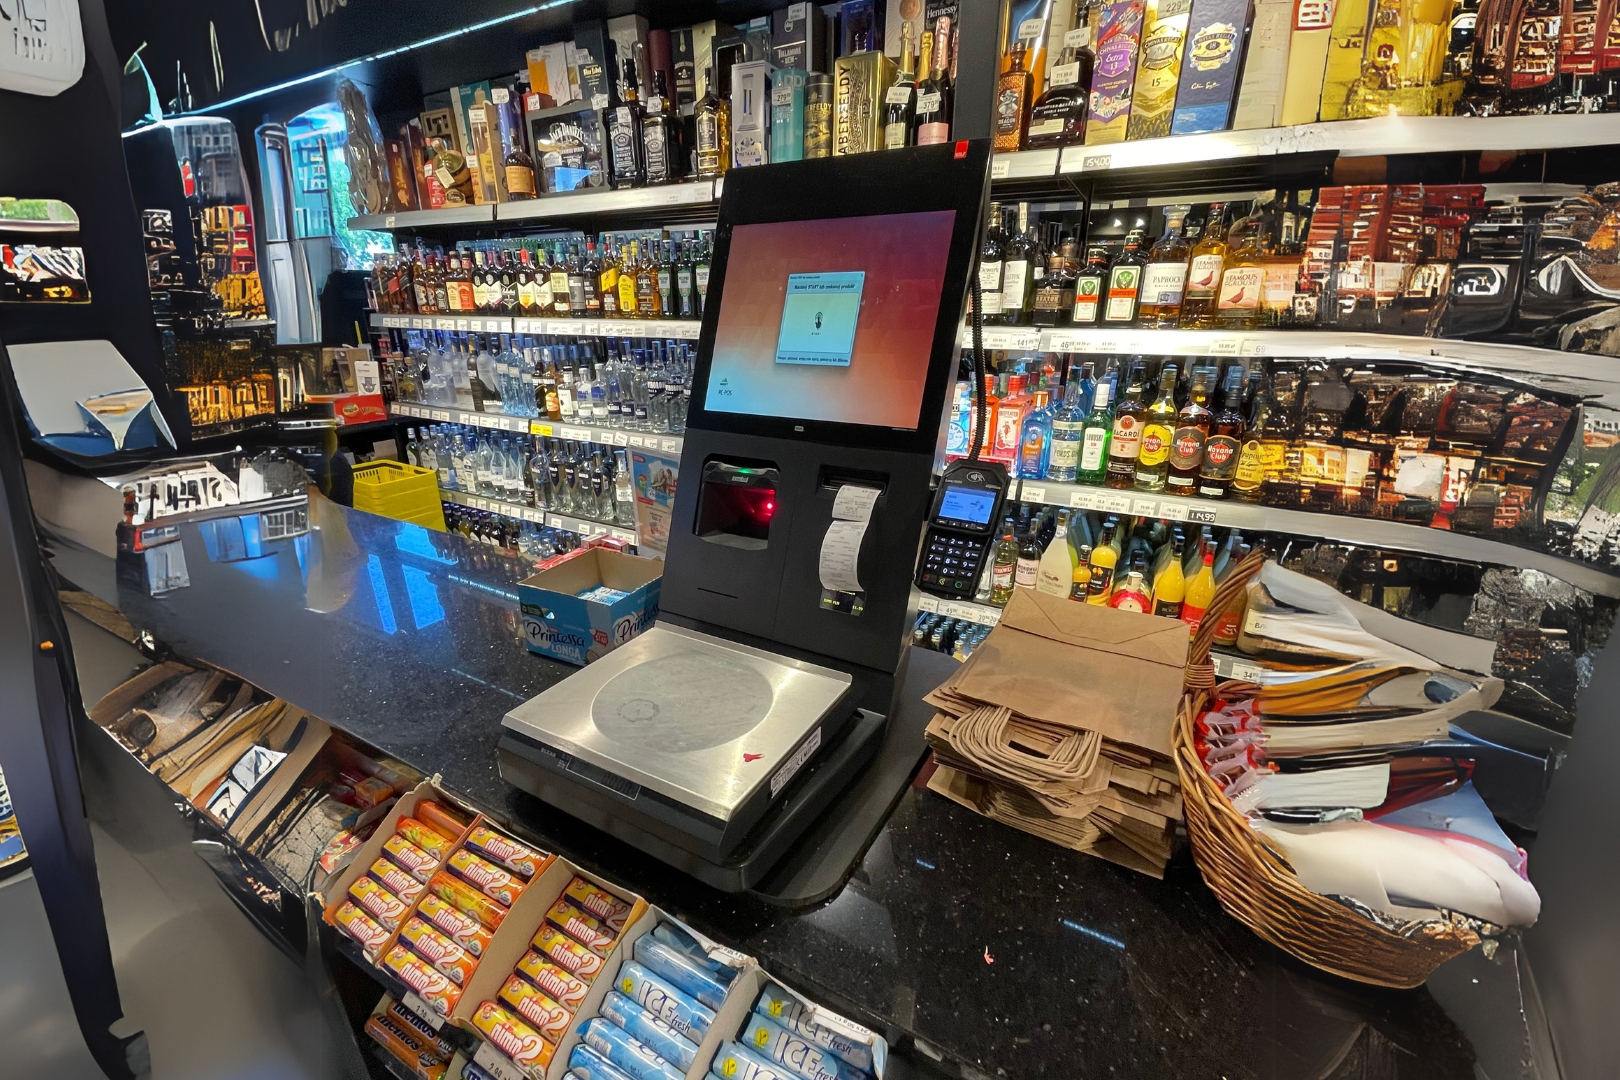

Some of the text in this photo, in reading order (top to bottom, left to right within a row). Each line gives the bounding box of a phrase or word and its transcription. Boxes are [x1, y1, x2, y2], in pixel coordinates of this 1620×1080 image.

[927, 5, 958, 18] Hennessy
[1100, 45, 1118, 54] CHIVAS
[1106, 53, 1124, 62] Extra
[1110, 62, 1118, 70] 13
[1152, 78, 1160, 86] 15
[838, 66, 850, 154] ABERFELDY
[549, 126, 562, 140] JACK
[1176, 439, 1200, 448] Havana
[1207, 445, 1234, 454] Havana
[616, 604, 660, 641] Princess
[526, 622, 585, 647] Princessa
[552, 644, 580, 658] LONGA
[638, 980, 679, 1020] ICE
[393, 1002, 437, 1038] mentos
[671, 1015, 691, 1033] fresh
[788, 1002, 830, 1046] ICE
[376, 1015, 420, 1050] mentos
[773, 1031, 824, 1076] ICE
[829, 1036, 852, 1055] fresh
